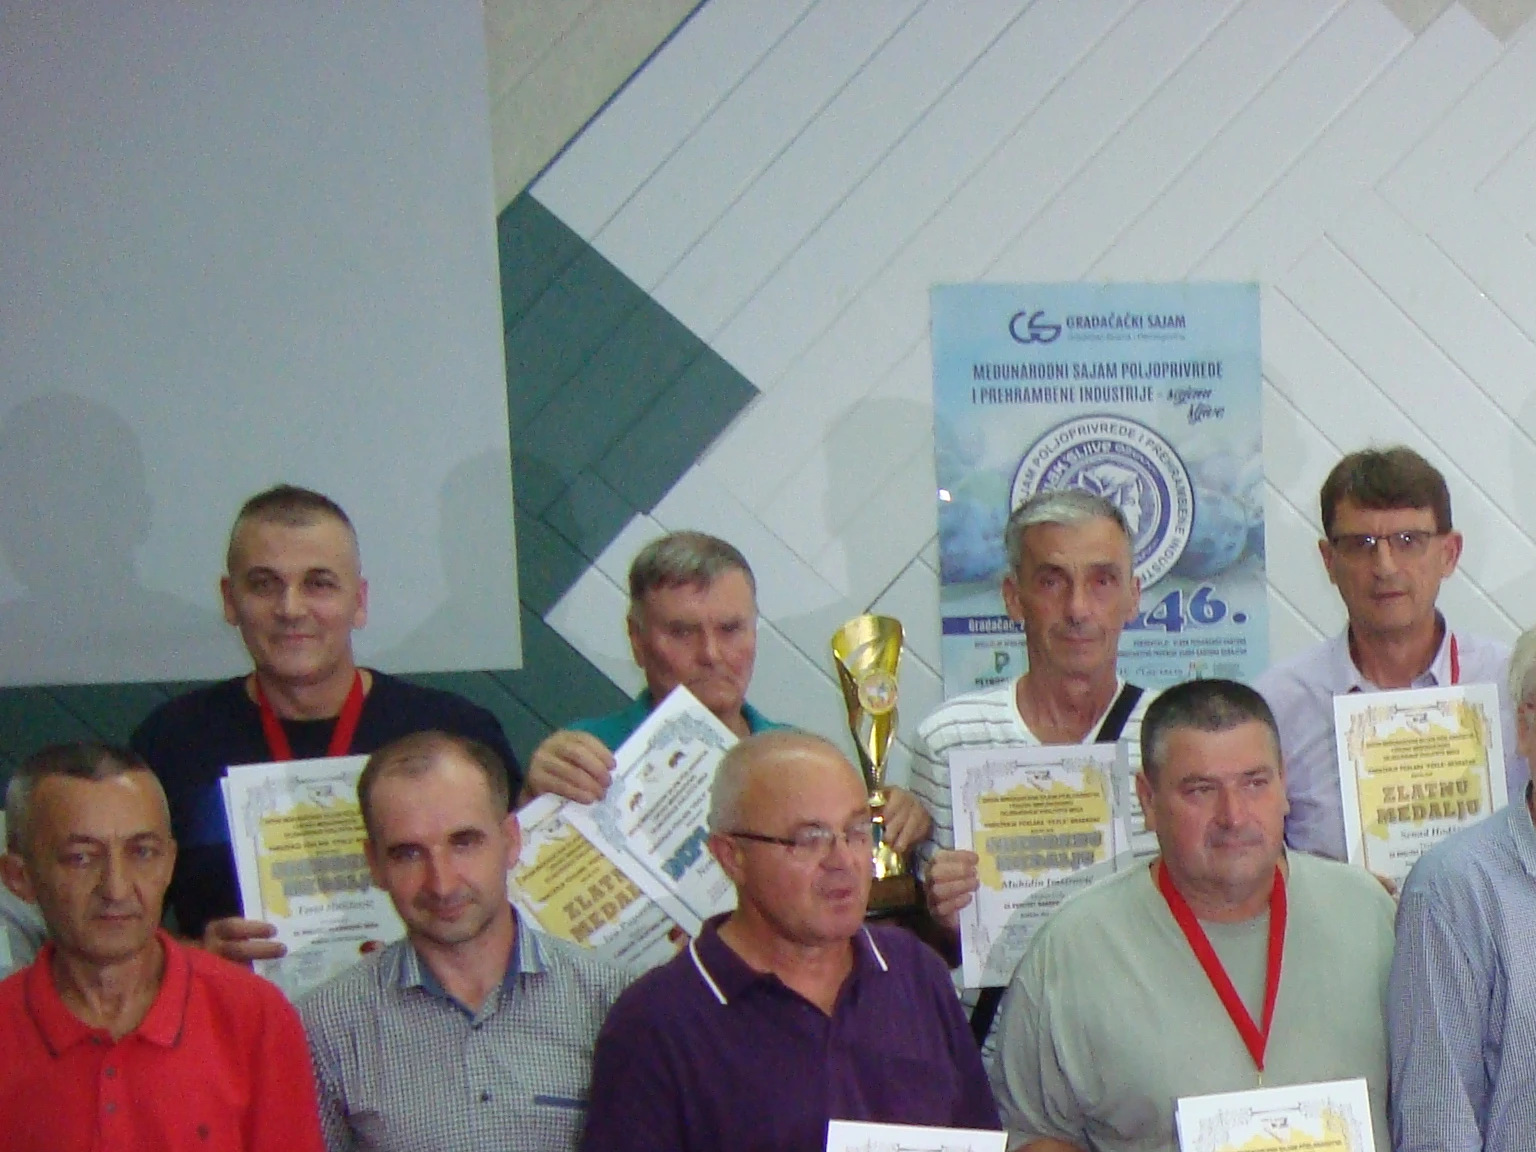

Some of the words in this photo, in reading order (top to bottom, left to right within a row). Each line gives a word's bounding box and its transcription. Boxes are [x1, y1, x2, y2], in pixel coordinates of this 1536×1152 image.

[1147, 314, 1186, 329] SAJAM
[1072, 361, 1118, 380] SAJAM
[1121, 359, 1223, 380] POLJOPRIVREDE
[980, 386, 1076, 404] PREHRAMBENE
[1079, 385, 1154, 402] INDUSTRIJE
[1144, 583, 1248, 633] 46.
[1383, 780, 1469, 803] ZLATNU
[1377, 800, 1480, 824] MEDALJU
